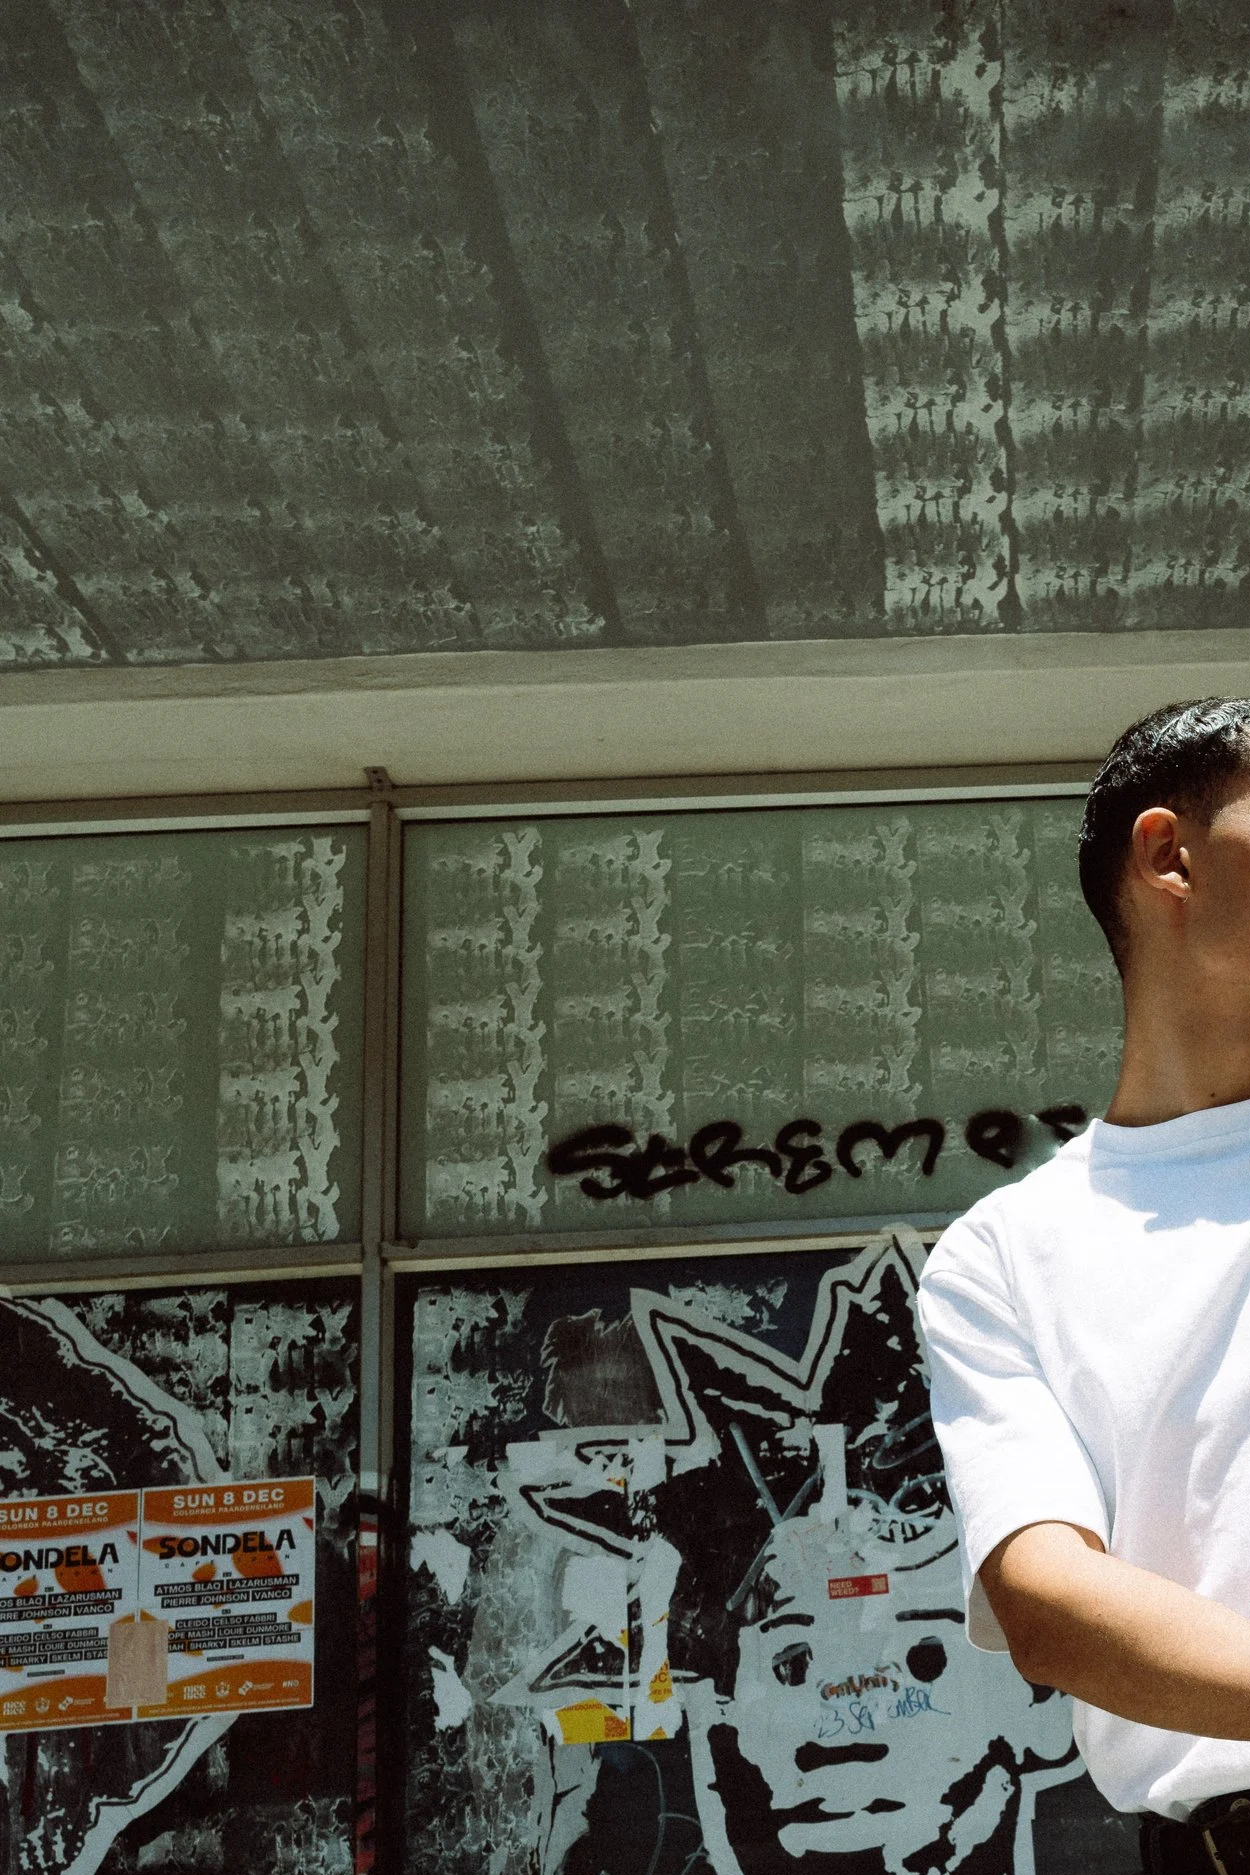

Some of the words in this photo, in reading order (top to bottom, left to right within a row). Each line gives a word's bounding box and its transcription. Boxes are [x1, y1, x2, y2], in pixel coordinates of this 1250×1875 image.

[173, 1493, 215, 1509] SUN
[223, 1491, 235, 1505] 8
[243, 1488, 285, 1504] DEC
[0, 1507, 38, 1523] SUN
[47, 1505, 58, 1519] 8
[66, 1502, 109, 1518] DEC
[159, 1529, 297, 1560] SONDELA
[0, 1542, 119, 1573] ONDELA
[156, 1585, 192, 1595] ATMOS
[229, 1577, 297, 1589] LAZARUSMAN
[51, 1591, 119, 1603] LAZARUSMAN
[163, 1597, 197, 1607] PIERRE
[200, 1593, 248, 1604] JOHNSON
[254, 1590, 290, 1600] VANCO
[21, 1608, 70, 1619] JOHNSON
[76, 1604, 112, 1614] VANCO
[177, 1619, 209, 1628] CLEIDO
[213, 1616, 242, 1625] CELSO
[67, 1639, 108, 1649] DUNMOR
